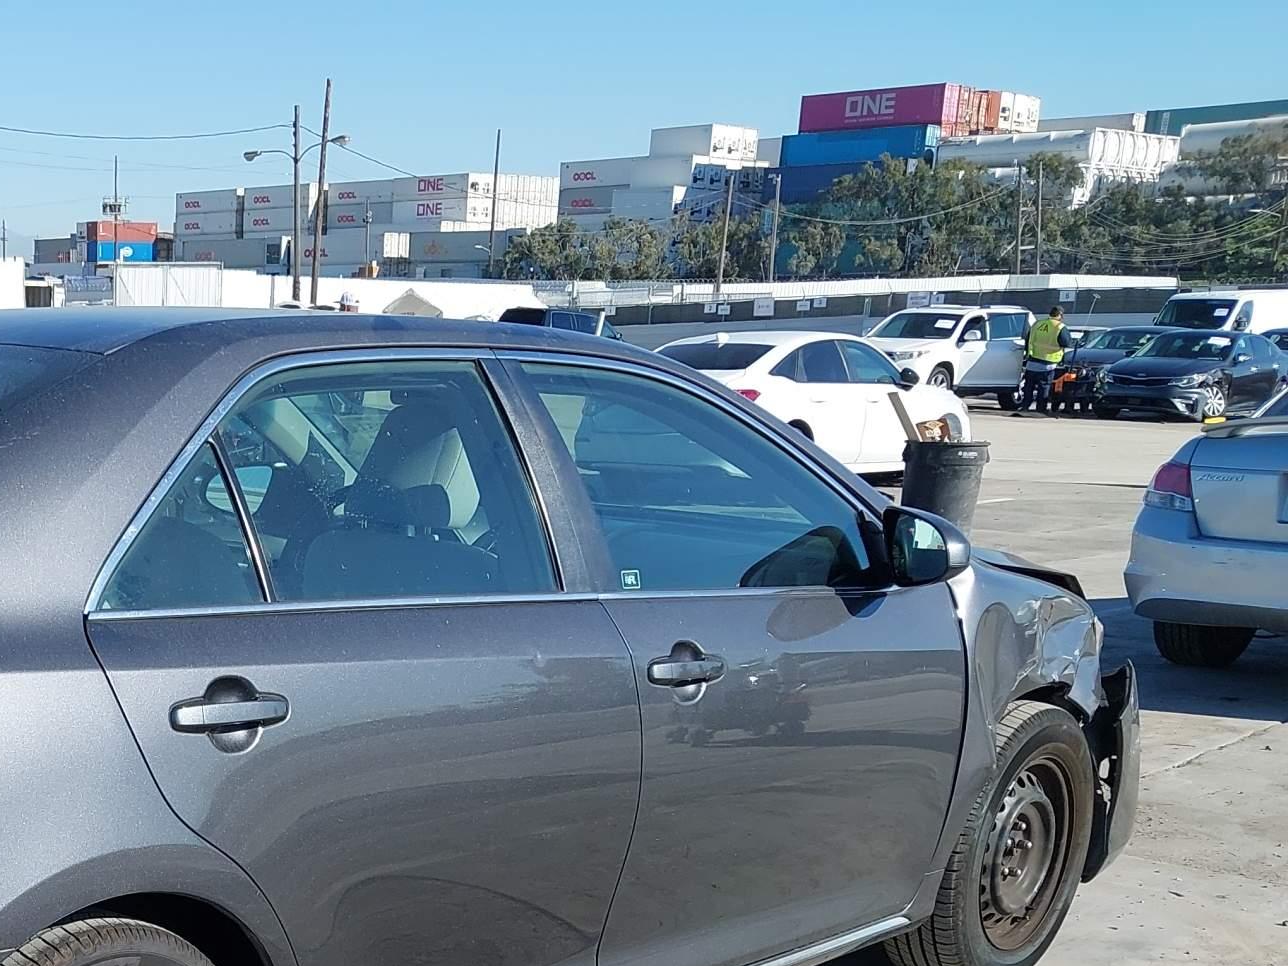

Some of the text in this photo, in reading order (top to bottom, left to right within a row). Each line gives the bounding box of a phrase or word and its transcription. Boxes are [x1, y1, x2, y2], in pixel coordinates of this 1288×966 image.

[845, 92, 896, 117] ONE
[572, 171, 597, 182] OOCL
[417, 177, 444, 193] ONE
[253, 195, 271, 205] OOCL
[338, 191, 357, 201] OOCL
[416, 202, 443, 217] ONE
[252, 217, 270, 227] OOCL
[337, 214, 356, 224] OOCL
